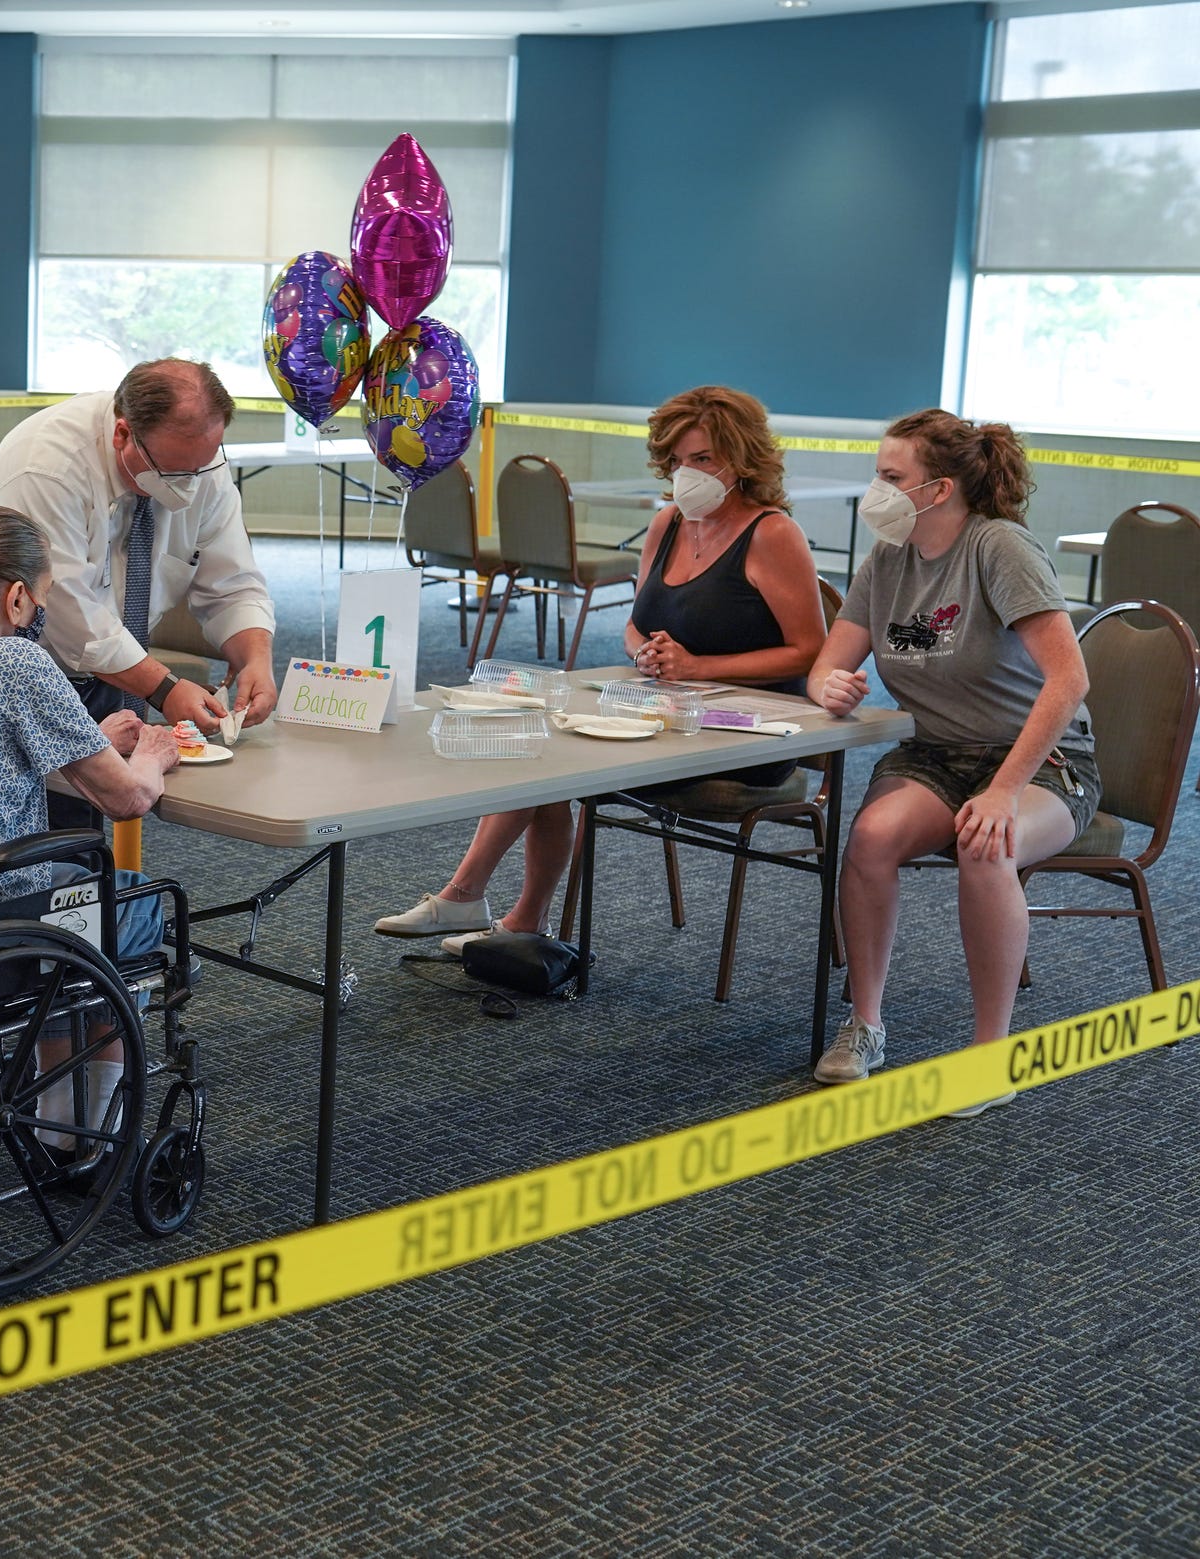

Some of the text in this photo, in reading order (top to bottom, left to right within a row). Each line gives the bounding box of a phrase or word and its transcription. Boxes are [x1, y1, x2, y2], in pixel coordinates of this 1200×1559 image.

[295, 414, 307, 437] 8
[368, 384, 439, 431] thday
[364, 615, 391, 669] 1
[293, 685, 368, 721] Barbara
[1008, 1005, 1142, 1084] CAUTION
[104, 1252, 281, 1352] ENTER
